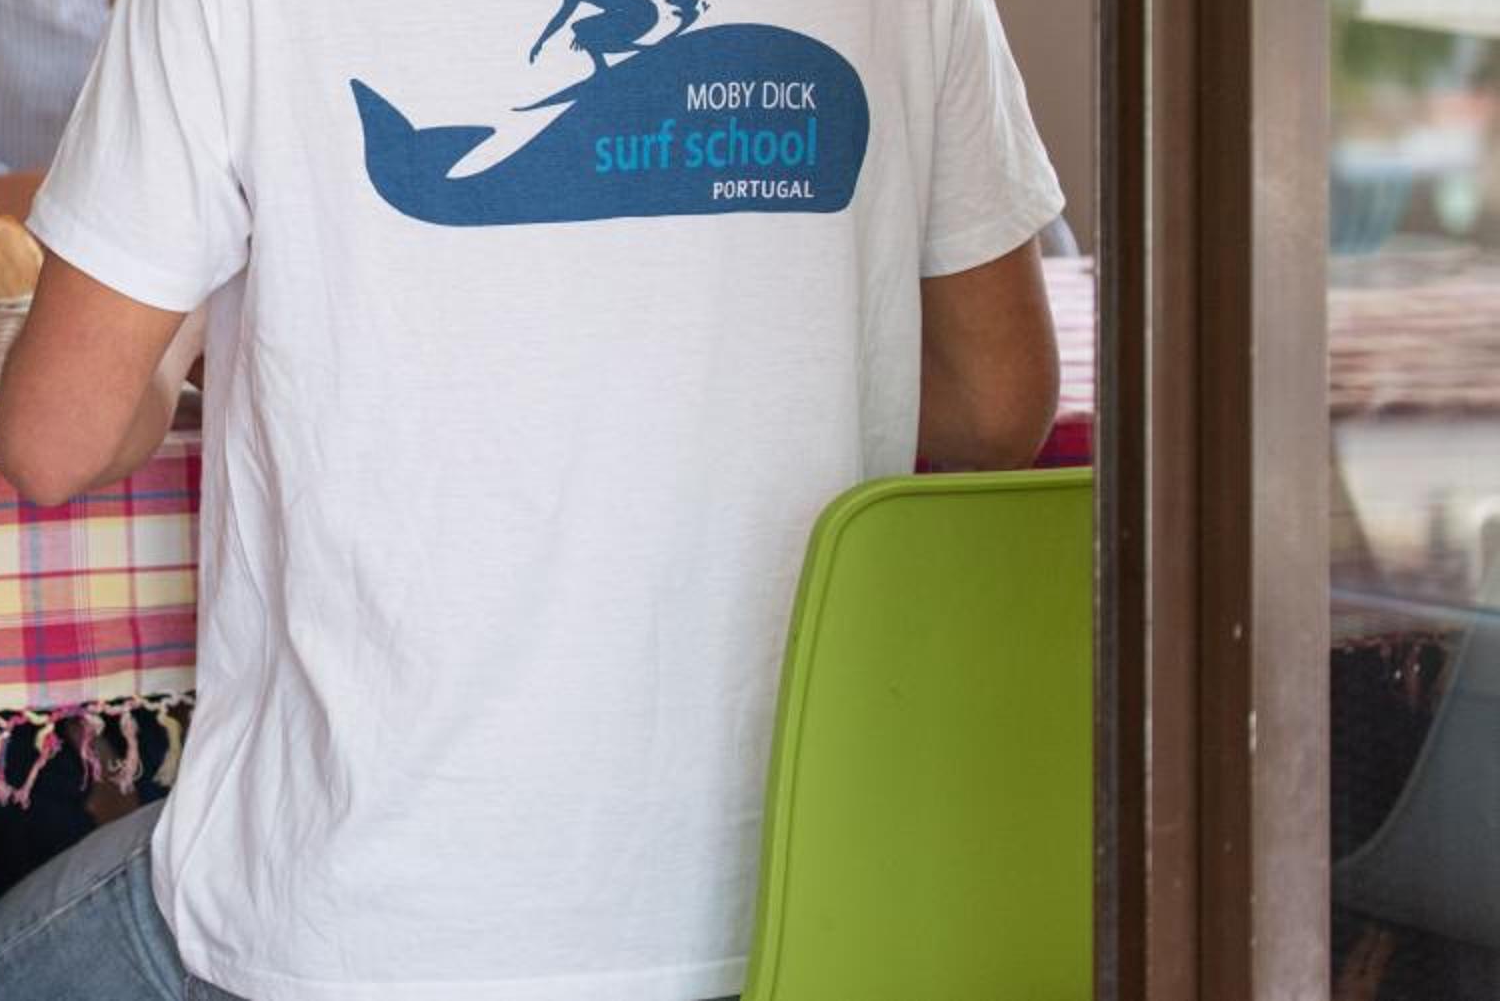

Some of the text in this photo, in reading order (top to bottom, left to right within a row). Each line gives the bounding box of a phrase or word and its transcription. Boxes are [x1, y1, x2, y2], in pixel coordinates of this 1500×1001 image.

[687, 82, 817, 111] MOBY DICK
[595, 116, 818, 173] surf school
[712, 180, 814, 199] PORTUGAL
